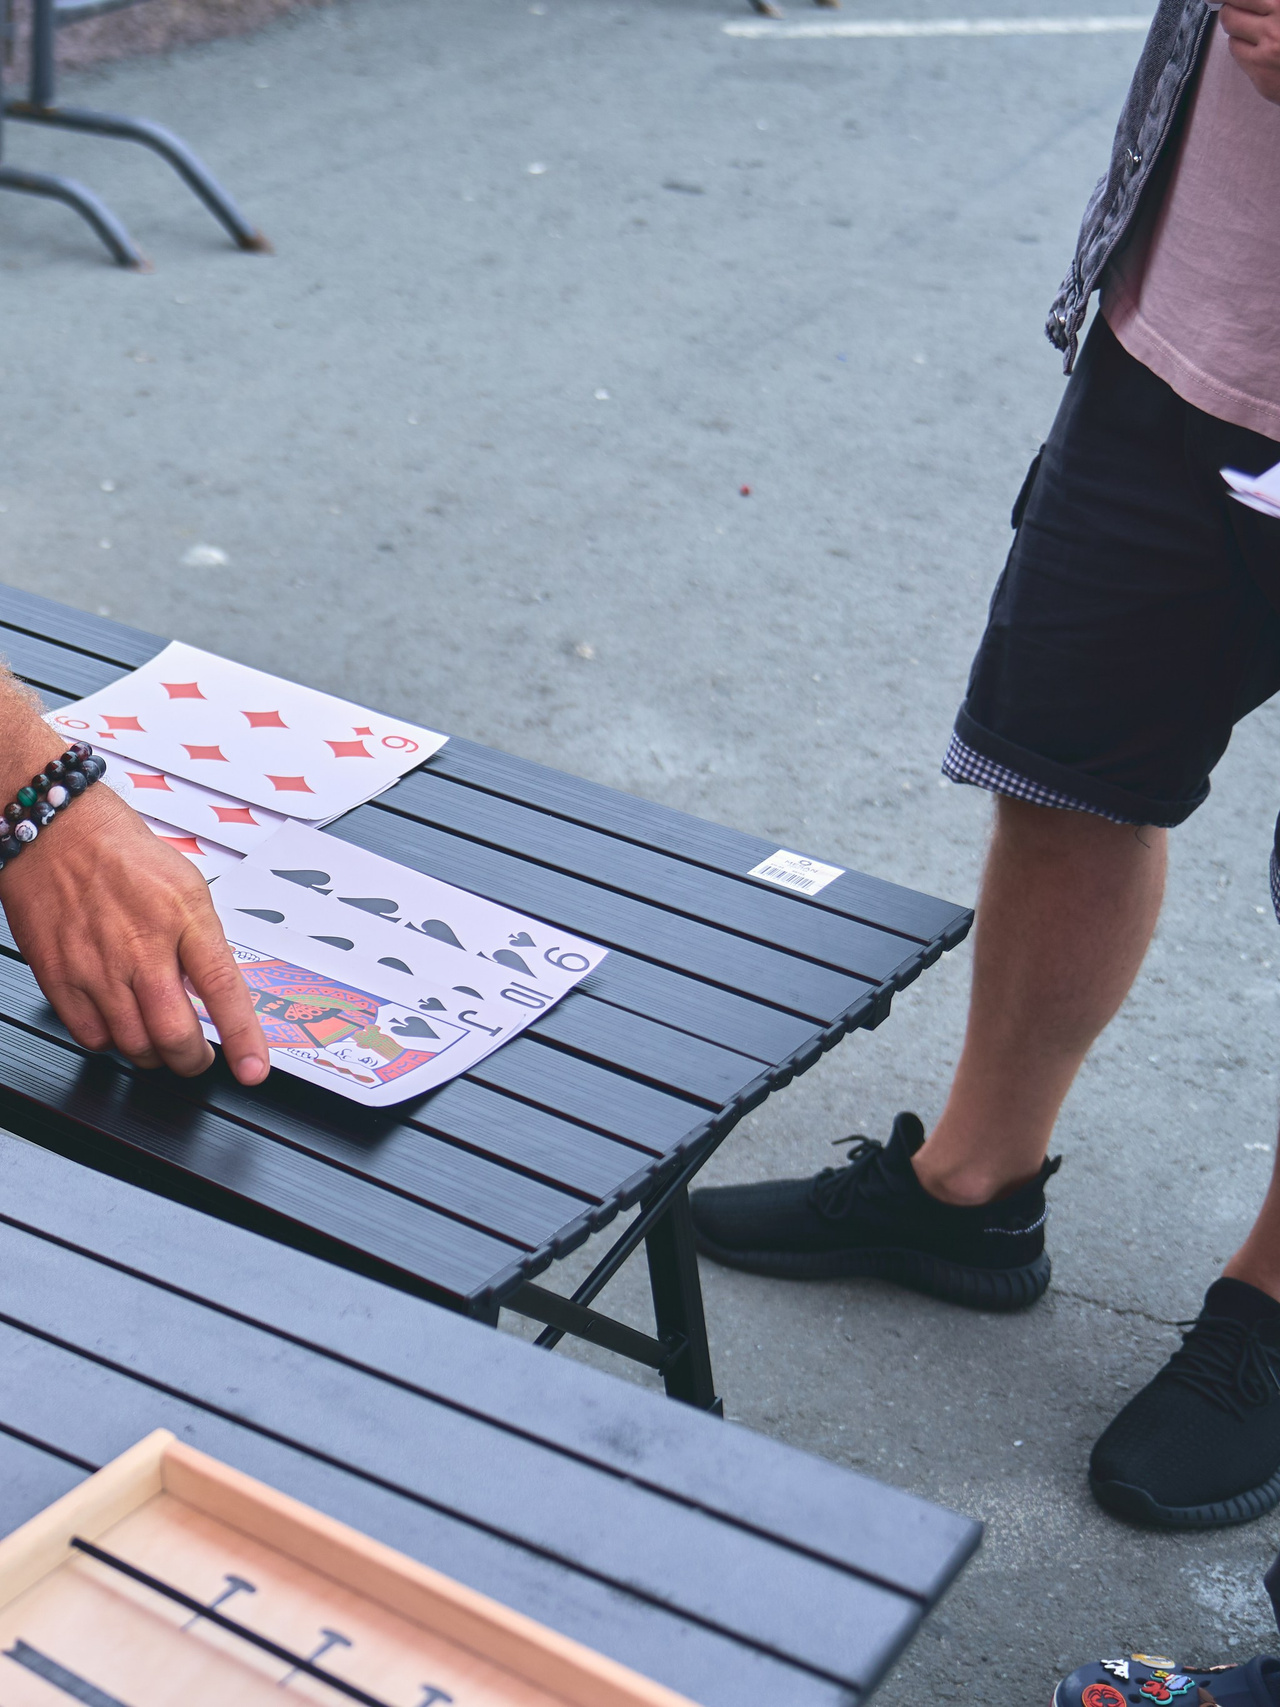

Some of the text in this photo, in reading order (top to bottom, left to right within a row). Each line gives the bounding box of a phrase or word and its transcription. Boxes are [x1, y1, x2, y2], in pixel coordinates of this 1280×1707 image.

[54, 715, 90, 730] 6
[381, 735, 419, 753] 6
[543, 946, 590, 973] 9
[499, 981, 554, 1010] 10
[457, 1009, 503, 1038] J
